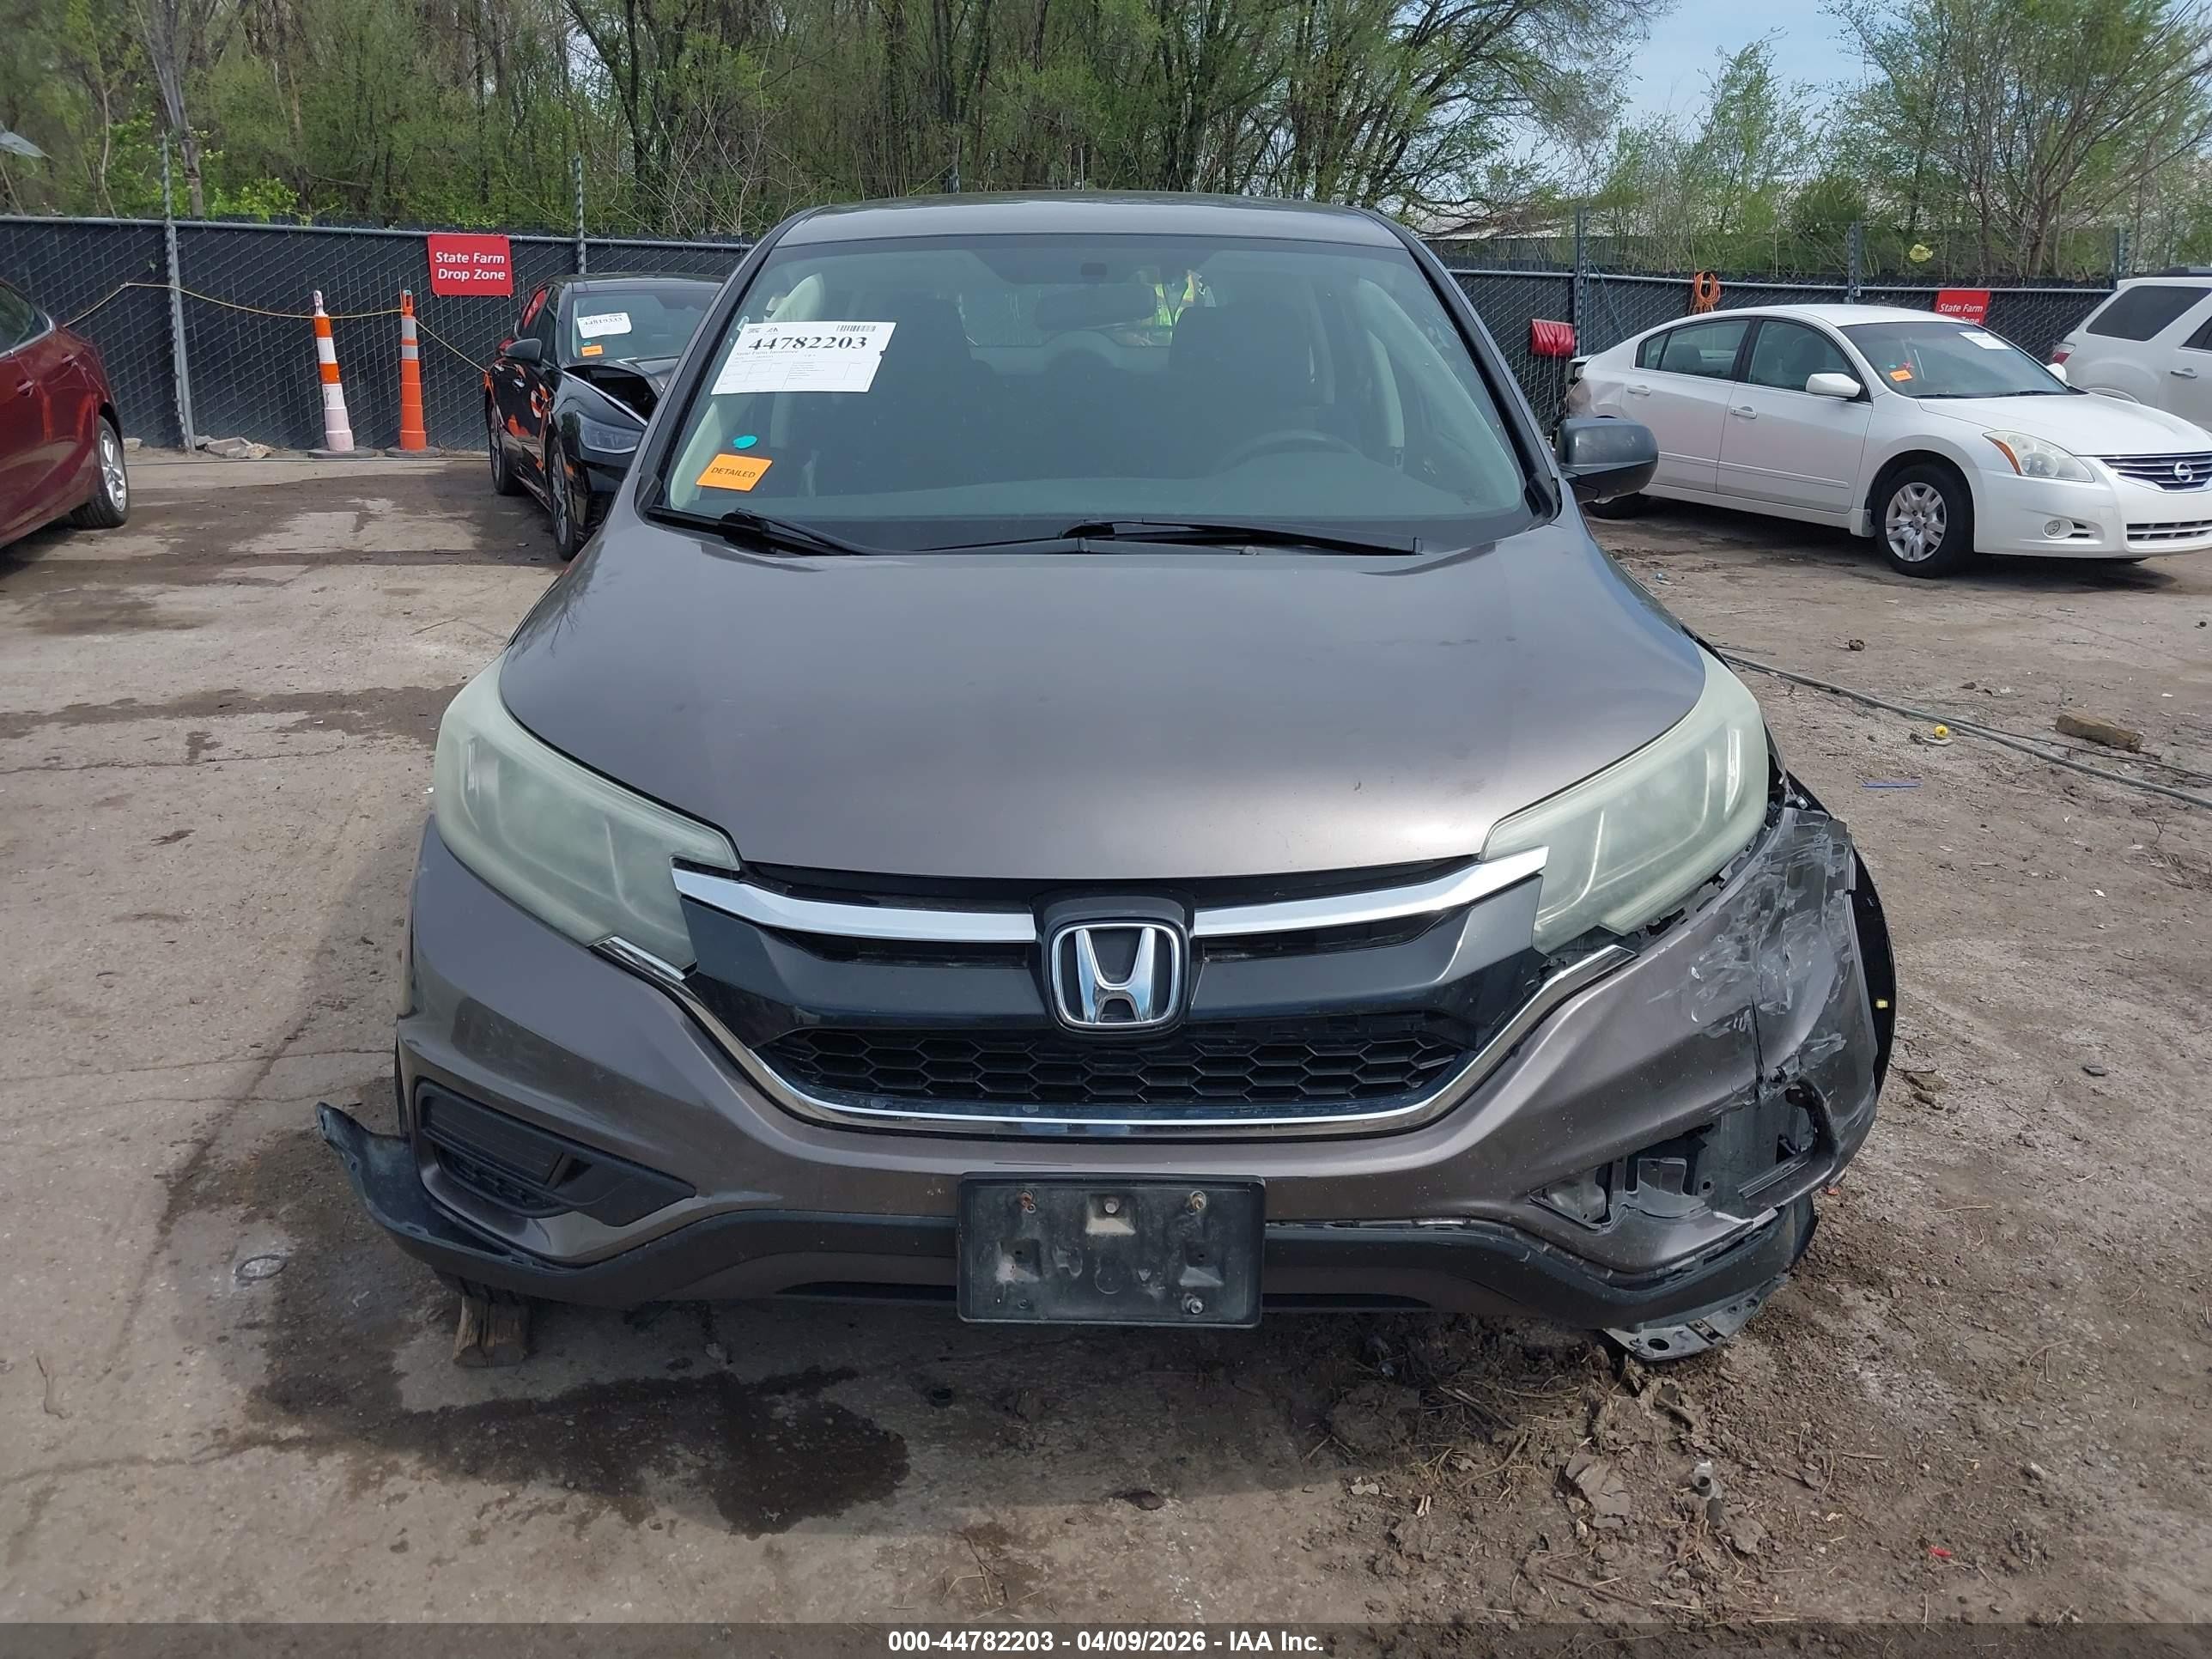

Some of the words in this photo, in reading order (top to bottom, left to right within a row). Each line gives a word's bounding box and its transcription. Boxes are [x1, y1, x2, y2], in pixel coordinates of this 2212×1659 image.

[434, 251, 470, 264] State
[472, 252, 505, 264] Farm
[437, 268, 471, 283] Drop
[472, 269, 506, 281] Zone
[1939, 303, 1962, 313] State
[1962, 303, 1984, 313] Farm
[748, 337, 867, 350] 44782203
[710, 466, 757, 478] DETAILED
